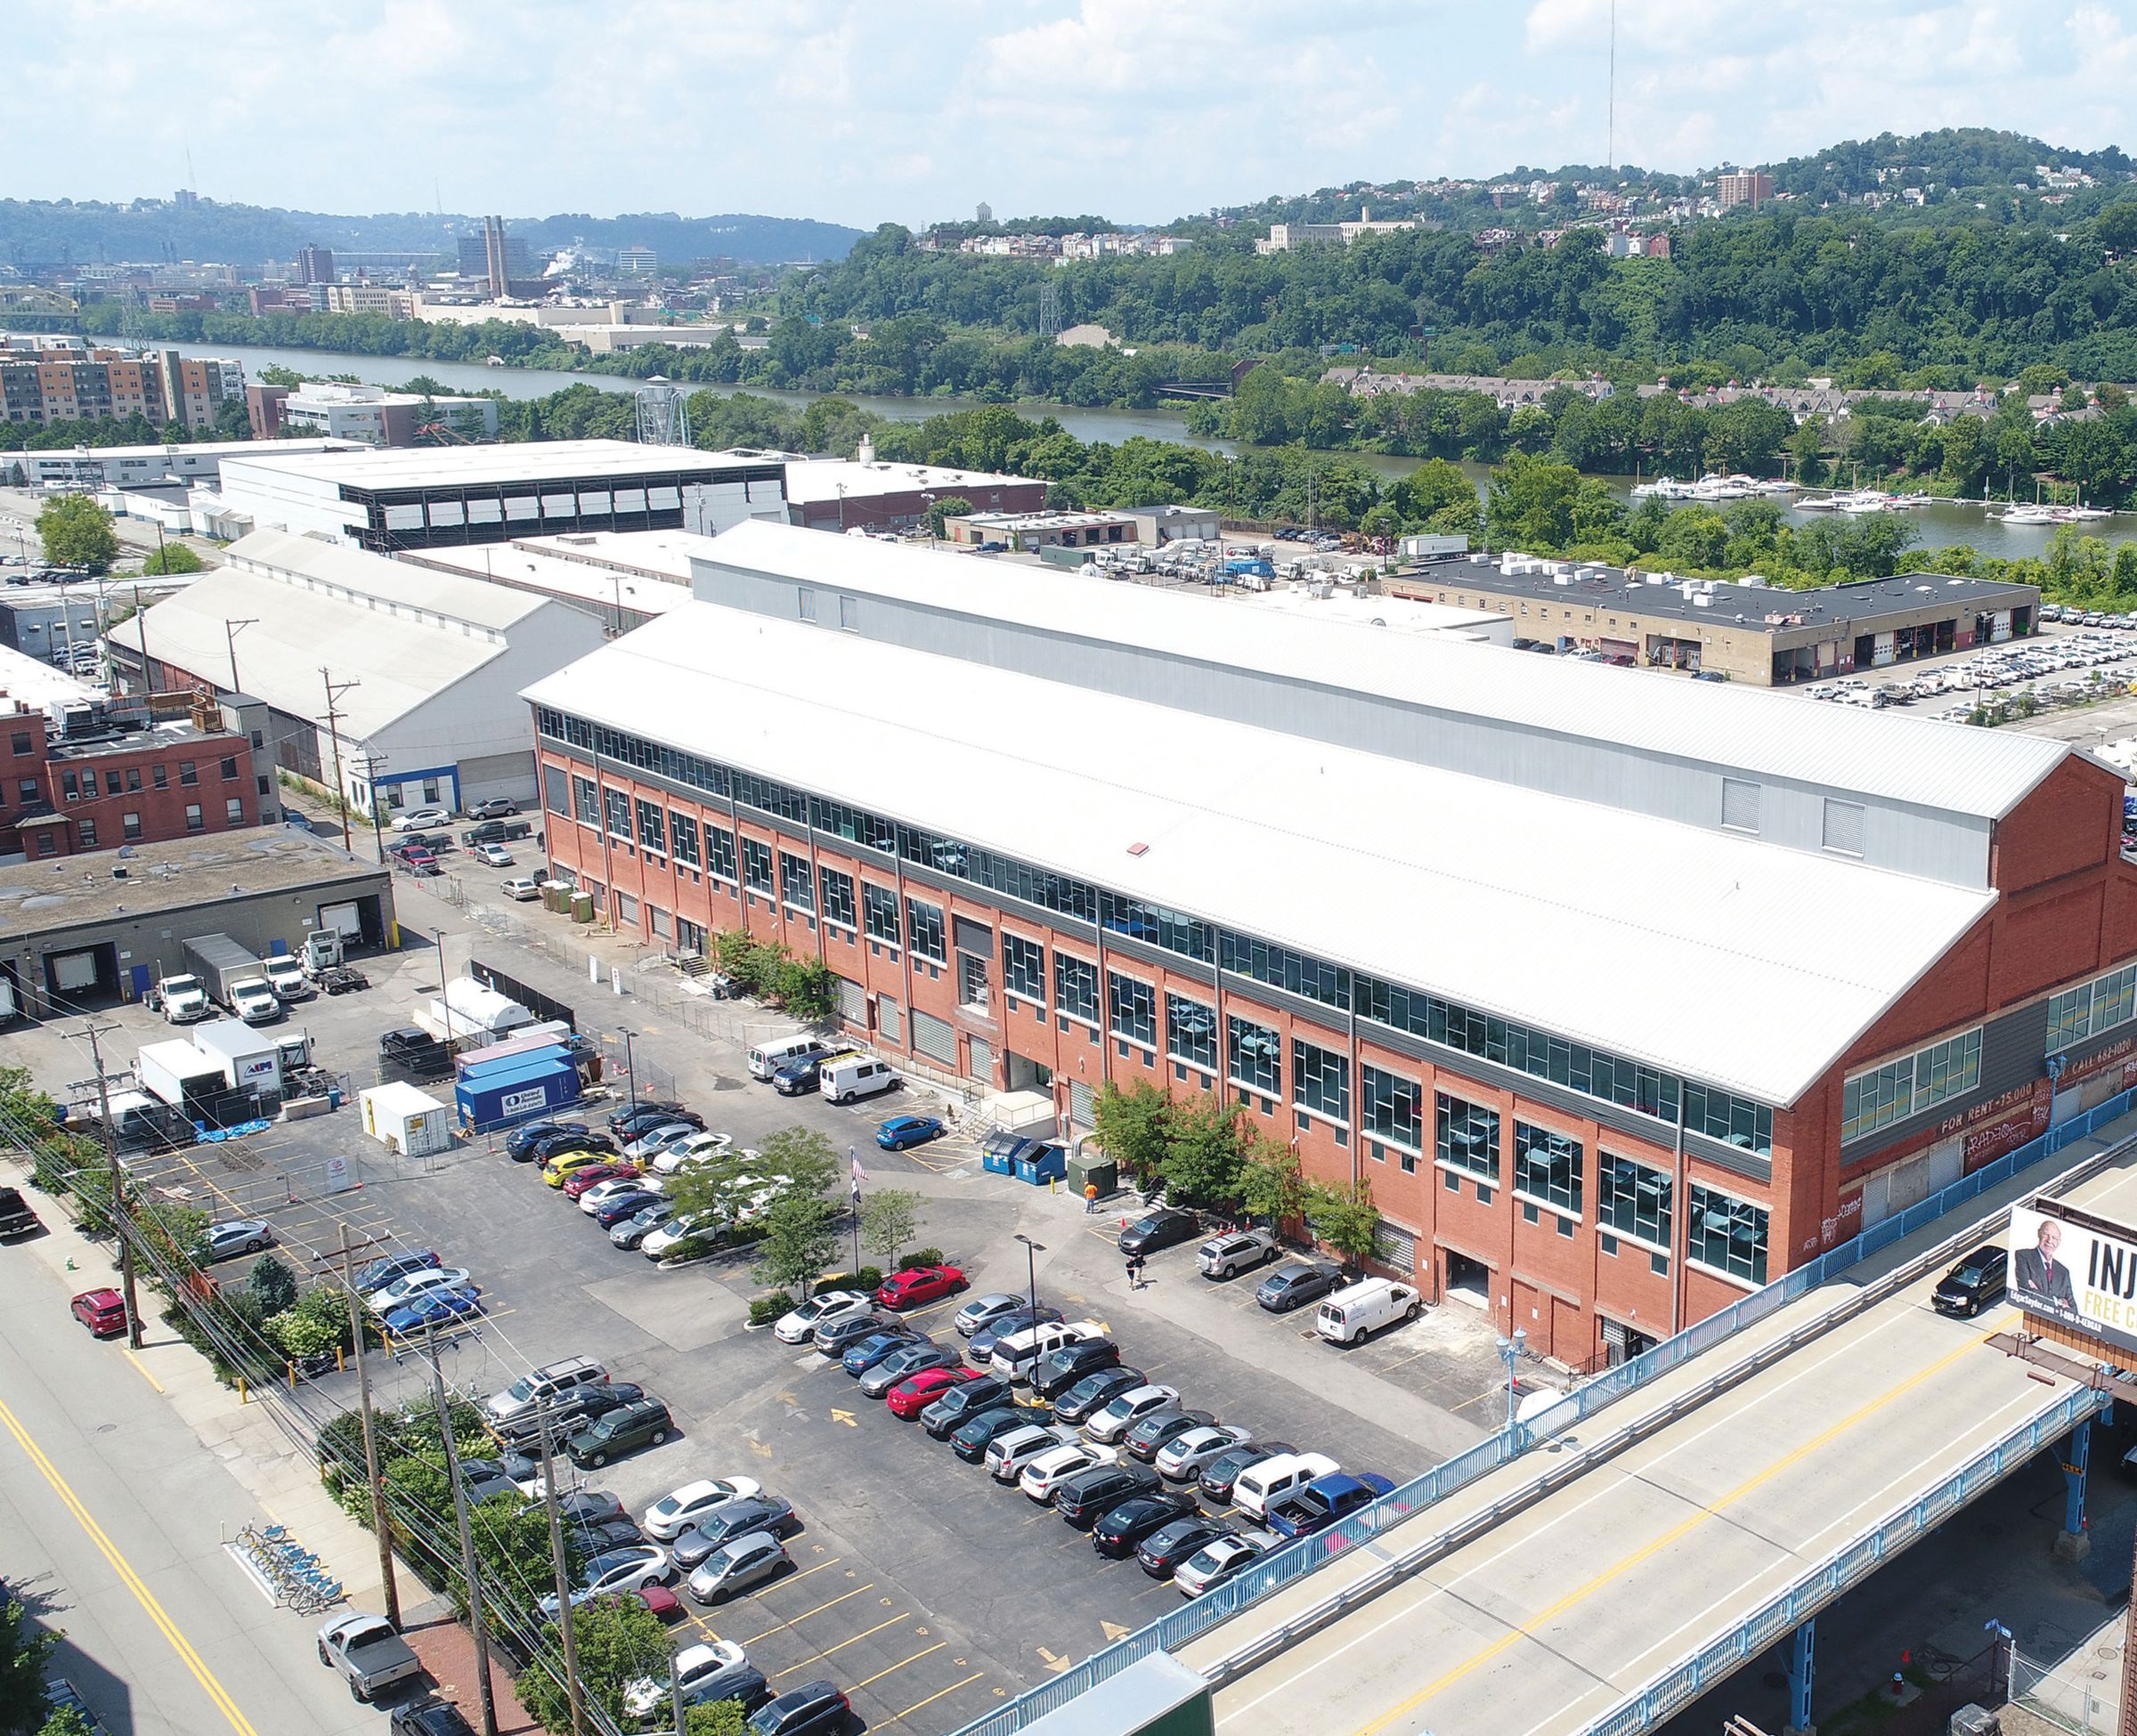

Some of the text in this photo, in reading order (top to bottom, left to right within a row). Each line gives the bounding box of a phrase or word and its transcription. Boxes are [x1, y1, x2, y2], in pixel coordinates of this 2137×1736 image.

[244, 1060, 272, 1075] AIM
[2072, 1057, 2092, 1075] CALL
[1941, 1114, 1962, 1134] FOR
[2084, 1290, 2121, 1324] FREE
[992, 1687, 1006, 1696] 49
